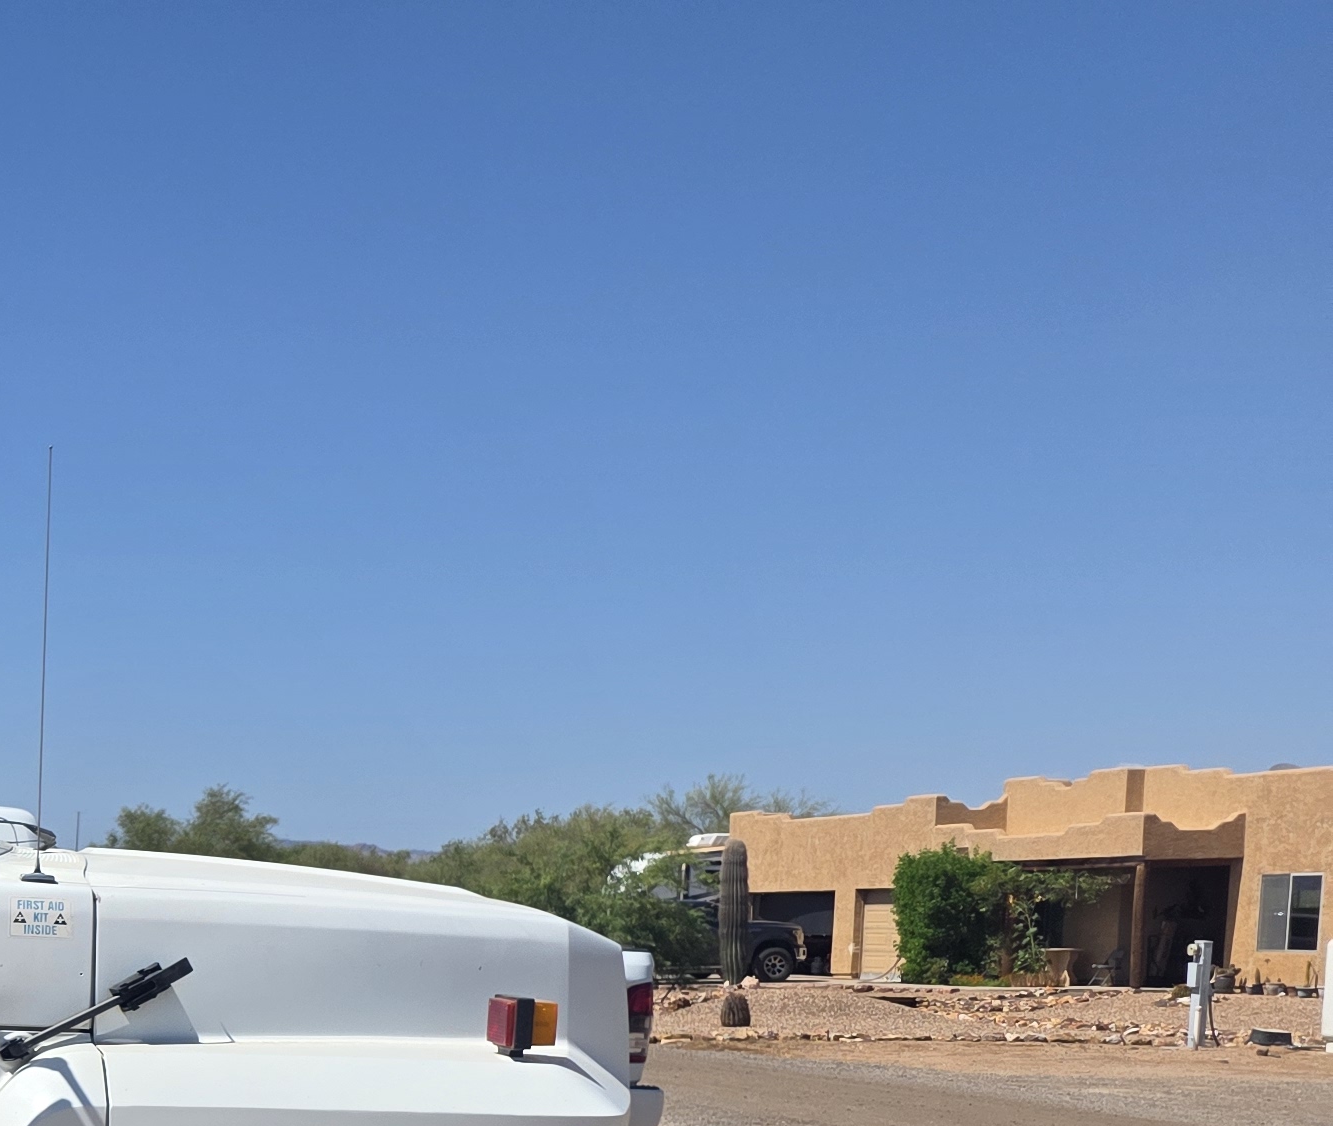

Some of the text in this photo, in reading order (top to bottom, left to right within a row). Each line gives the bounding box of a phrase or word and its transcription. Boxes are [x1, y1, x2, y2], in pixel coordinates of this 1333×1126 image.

[17, 900, 64, 911] FIRST AID
[33, 912, 49, 922] KIT
[23, 925, 57, 935] INSIDE
